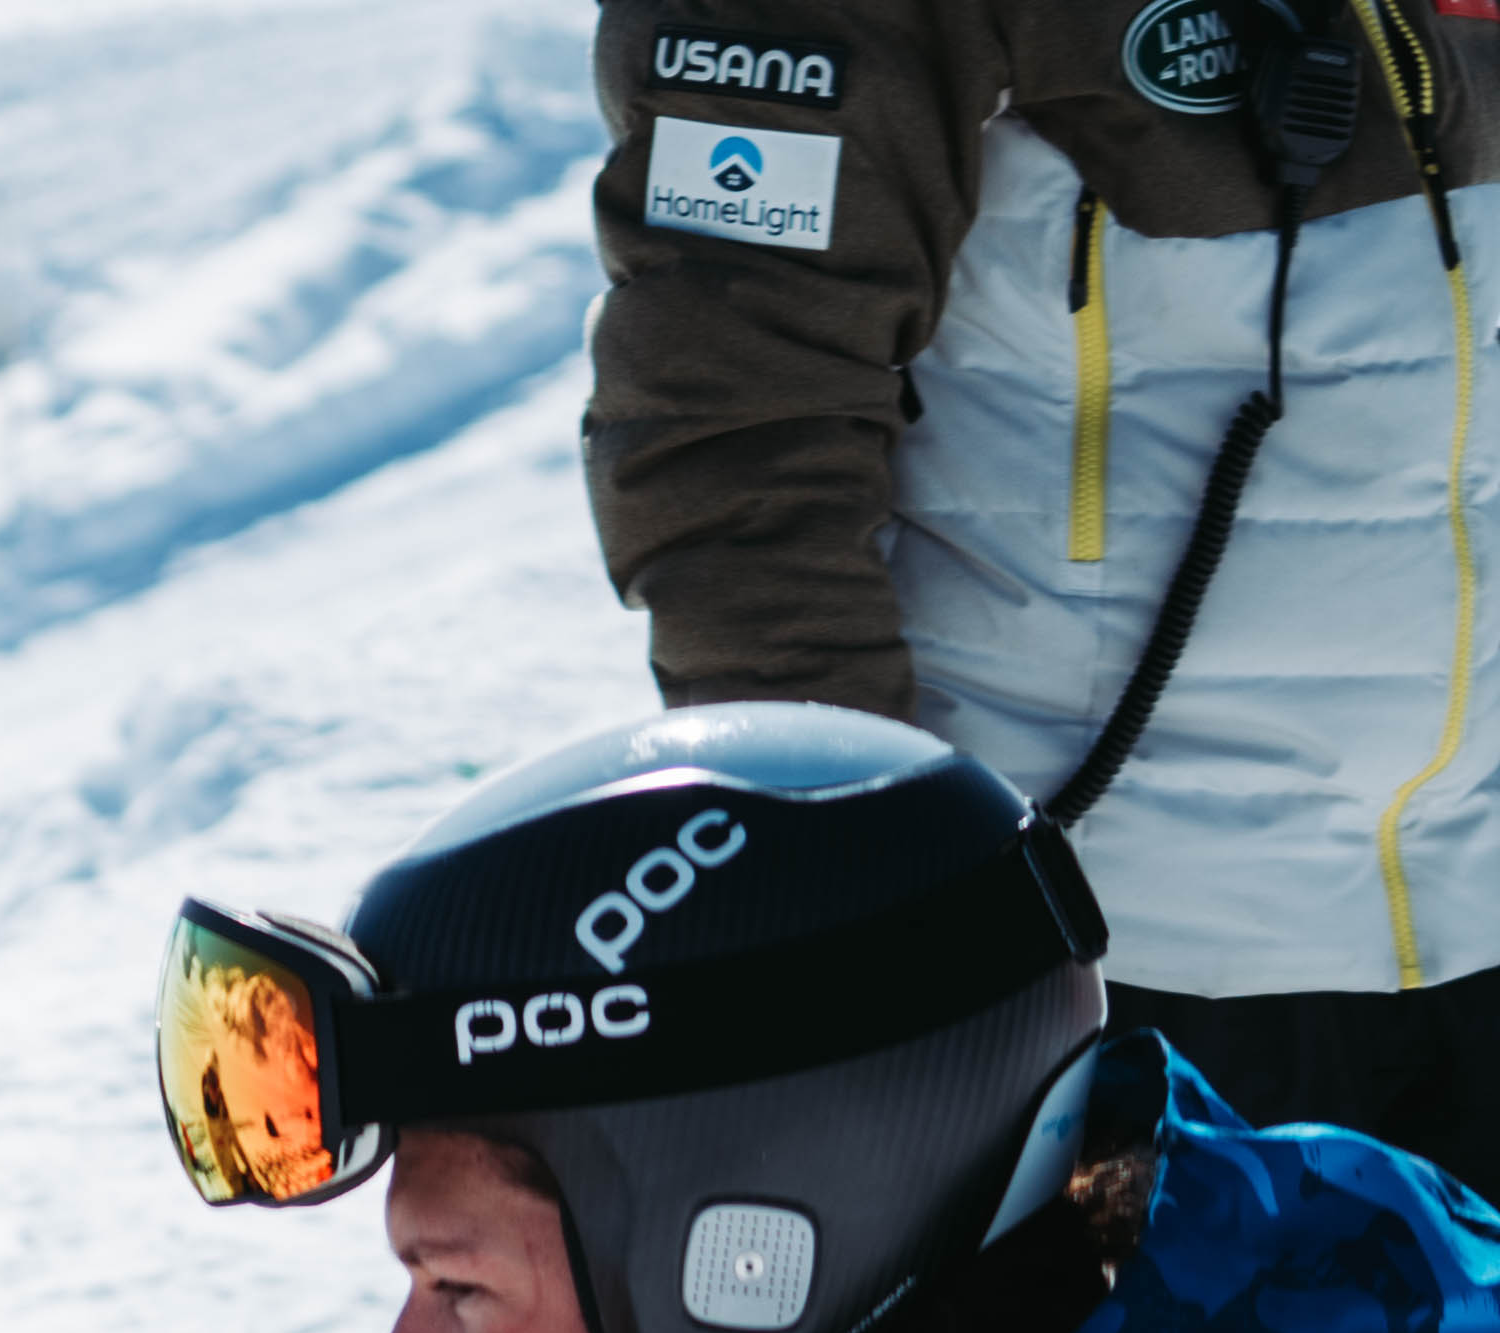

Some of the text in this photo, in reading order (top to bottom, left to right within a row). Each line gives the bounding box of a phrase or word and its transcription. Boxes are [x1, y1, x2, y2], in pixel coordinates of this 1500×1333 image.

[655, 38, 835, 98] USANA
[1179, 45, 1248, 87] ROV
[652, 185, 821, 237] HomeLight
